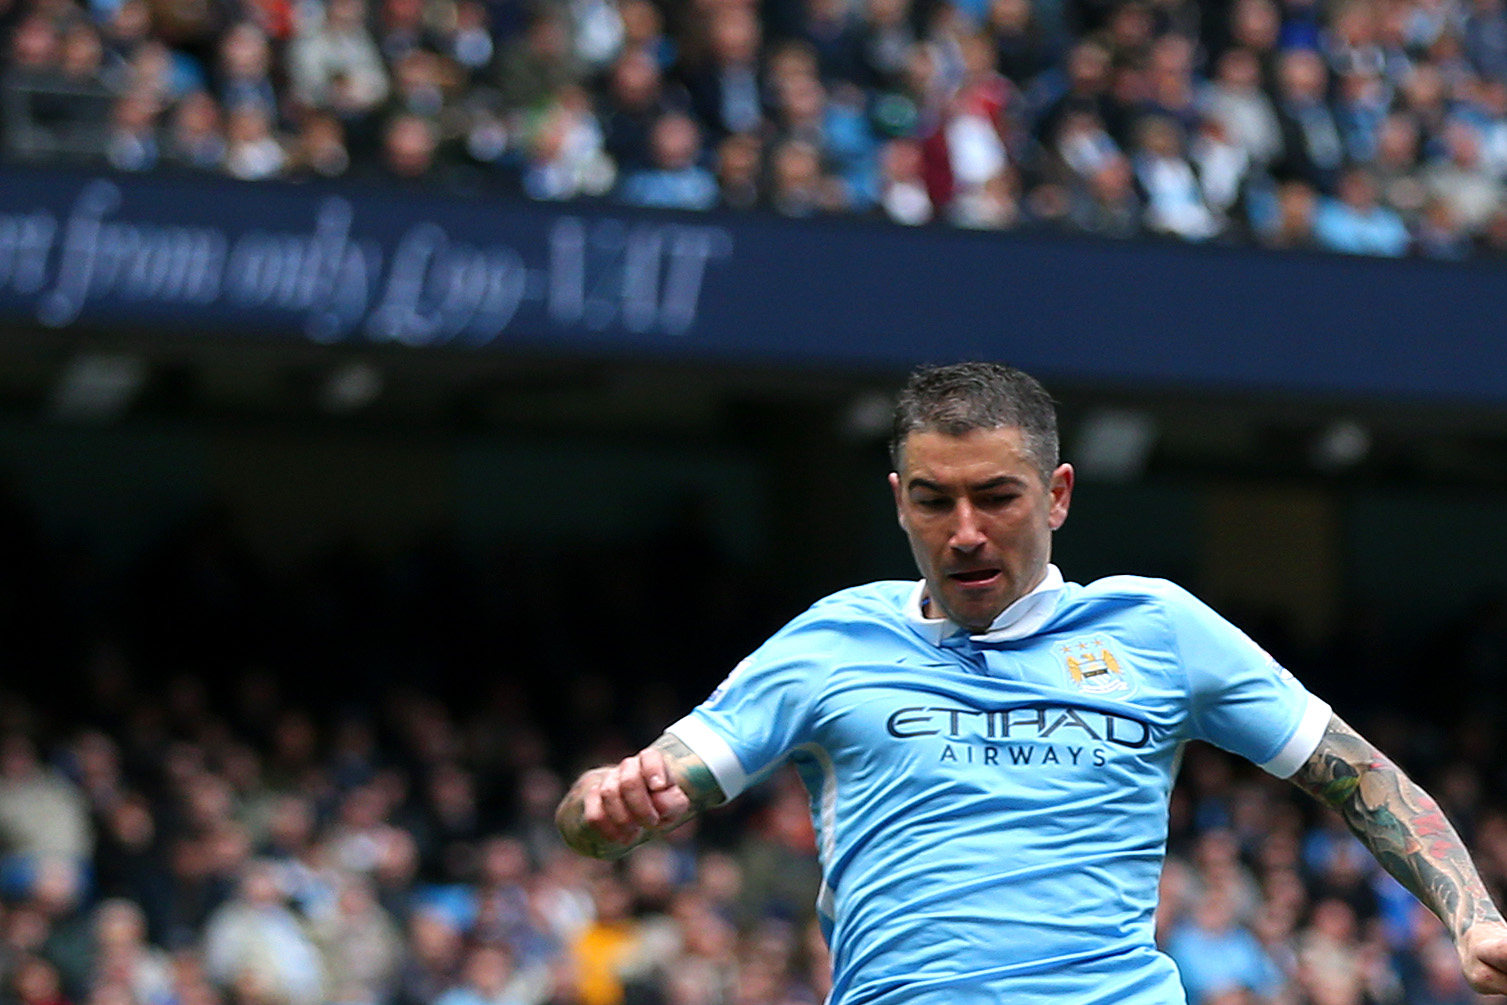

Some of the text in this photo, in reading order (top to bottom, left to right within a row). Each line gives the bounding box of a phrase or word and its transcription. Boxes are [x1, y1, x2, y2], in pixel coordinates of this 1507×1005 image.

[36, 180, 226, 328] from
[224, 196, 382, 344] only
[886, 706, 1152, 748] ETIHAD
[939, 744, 1106, 768] AIRWAYS
